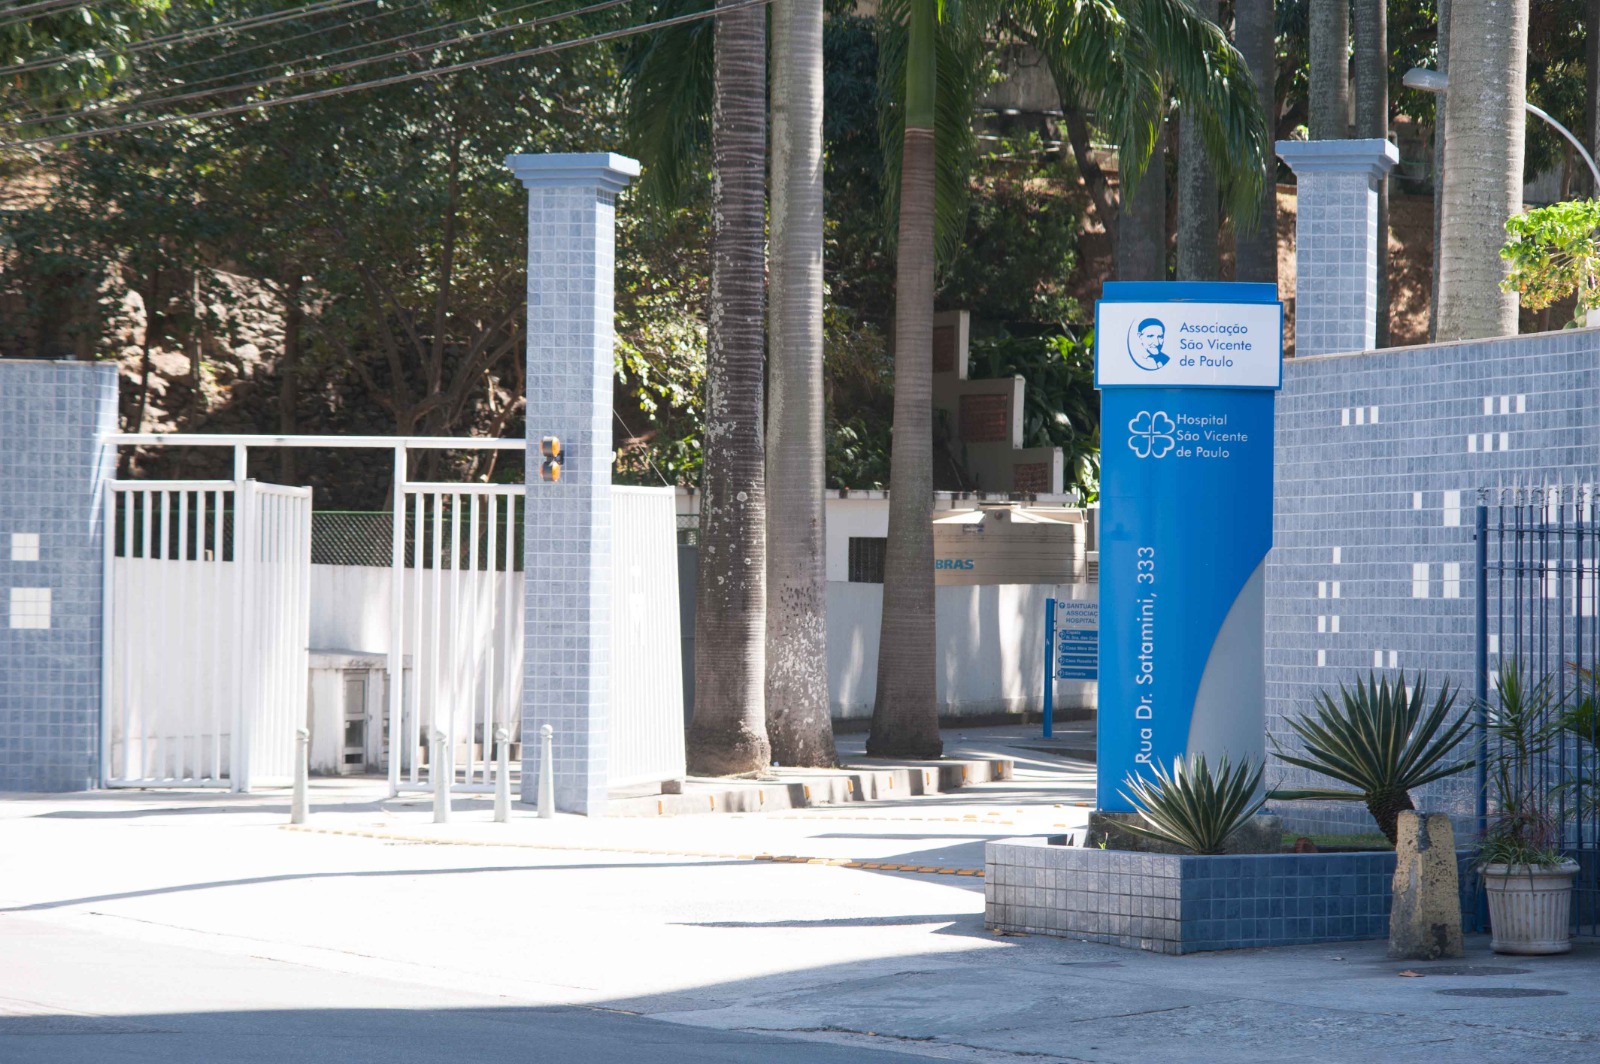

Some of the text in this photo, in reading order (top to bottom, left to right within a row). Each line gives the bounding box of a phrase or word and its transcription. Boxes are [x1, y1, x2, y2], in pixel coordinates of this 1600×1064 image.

[1180, 322, 1248, 336] Associação
[1180, 338, 1252, 351] São Vicente
[1180, 355, 1233, 367] de Paulo
[1177, 414, 1227, 427] Hospital
[1177, 430, 1248, 442] São Vicente
[1176, 446, 1230, 458] de Paulo
[935, 559, 975, 570] BRAS
[1135, 546, 1158, 764] Rua Dr. Satamini, 333
